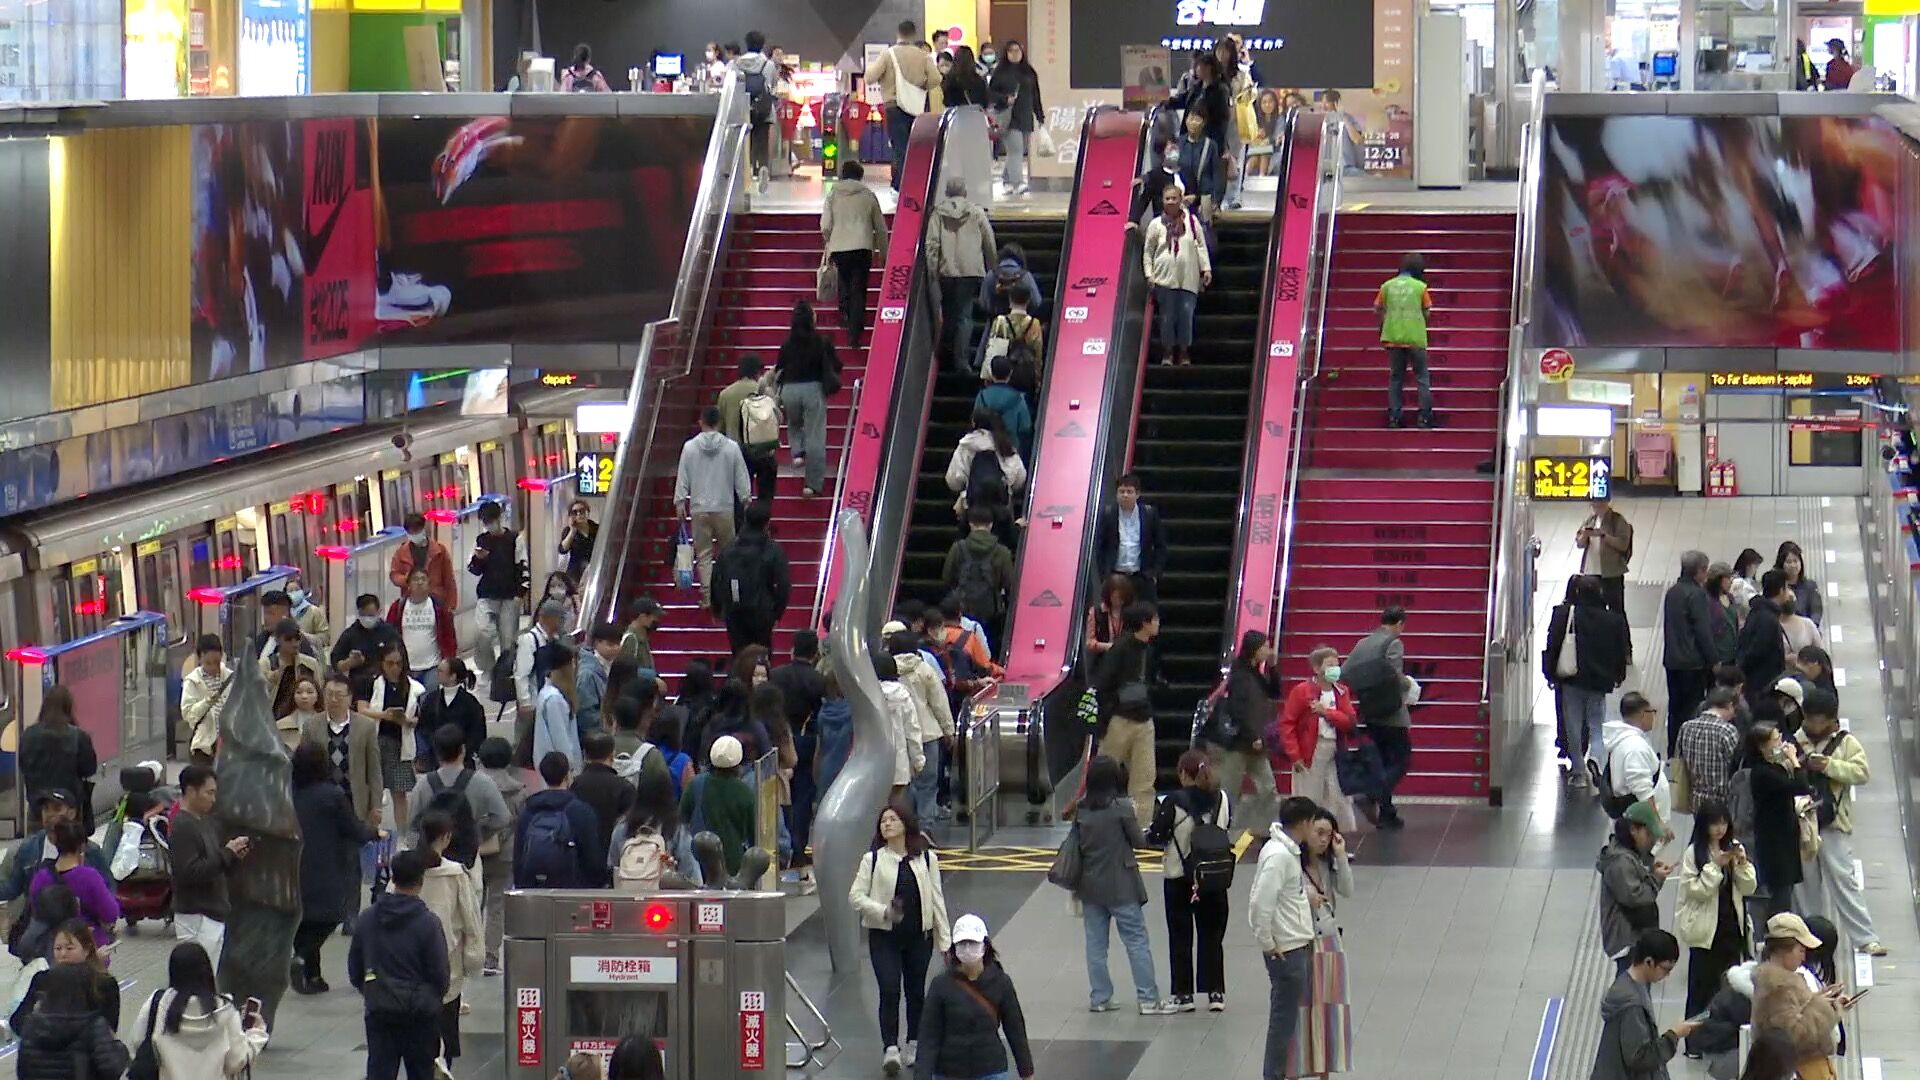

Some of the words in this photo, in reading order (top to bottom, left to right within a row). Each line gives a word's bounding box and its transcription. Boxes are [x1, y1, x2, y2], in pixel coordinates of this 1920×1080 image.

[1364, 147, 1401, 160] 12/31
[1712, 374, 1725, 385] To
[1742, 374, 1776, 385] Eastern
[599, 458, 613, 480] 2
[598, 960, 651, 973] 消防栓箱
[522, 1011, 536, 1054] 滅火器
[745, 1014, 760, 1058] 滅火器
